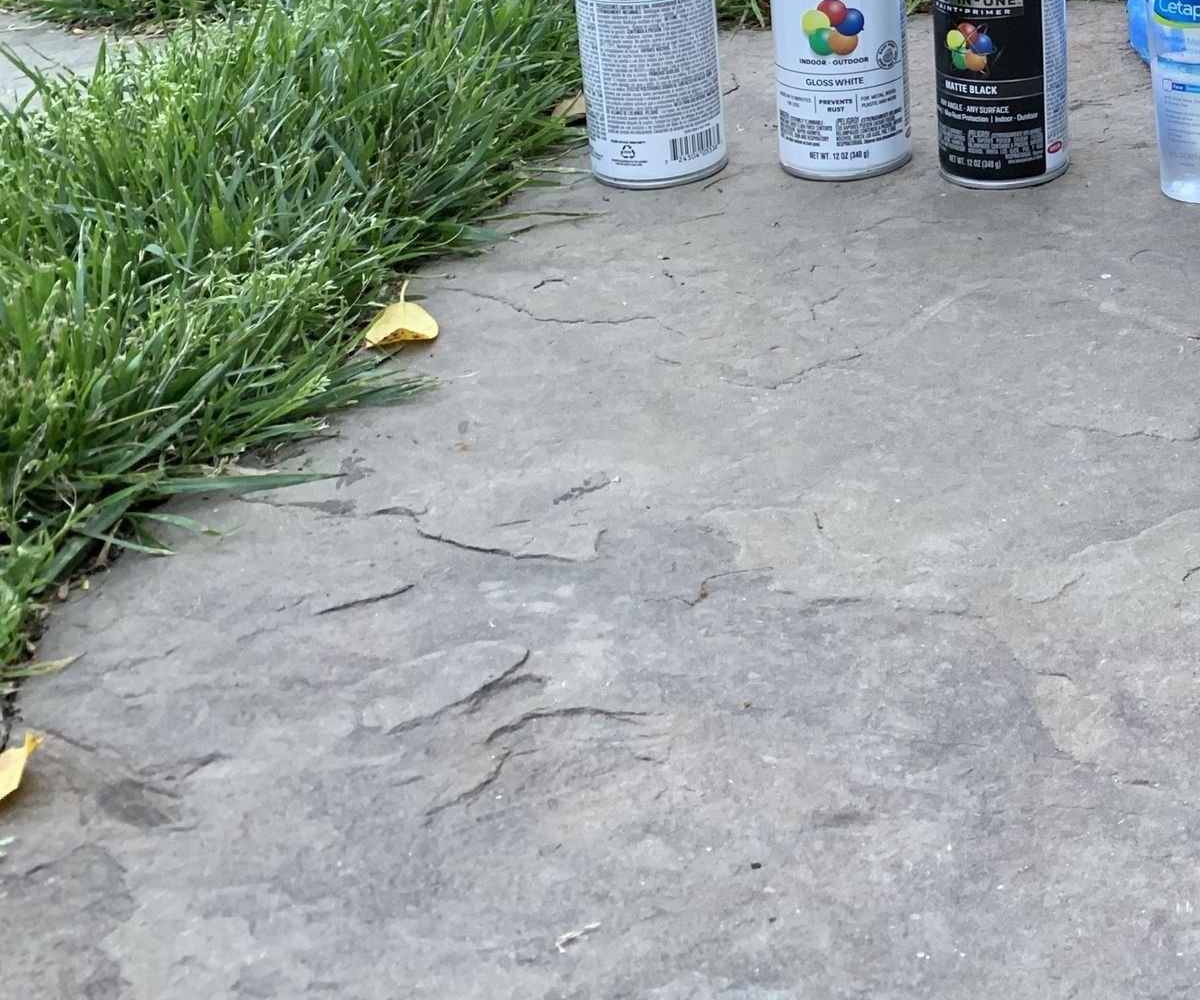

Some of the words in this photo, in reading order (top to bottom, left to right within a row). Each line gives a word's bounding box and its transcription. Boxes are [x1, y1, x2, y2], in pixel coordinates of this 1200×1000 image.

[799, 58, 827, 66] INDOOR
[832, 56, 869, 65] OUTDOOR
[806, 78, 834, 86] GLOSS
[835, 77, 864, 86] WHITE
[945, 80, 968, 93] MATTE
[969, 85, 998, 95] BLACK
[966, 105, 979, 113] ANY
[979, 106, 1010, 114] SURFACE
[810, 151, 819, 160] NET
[833, 152, 840, 160] 12
[840, 151, 849, 160] OZ
[966, 158, 973, 167] 12
